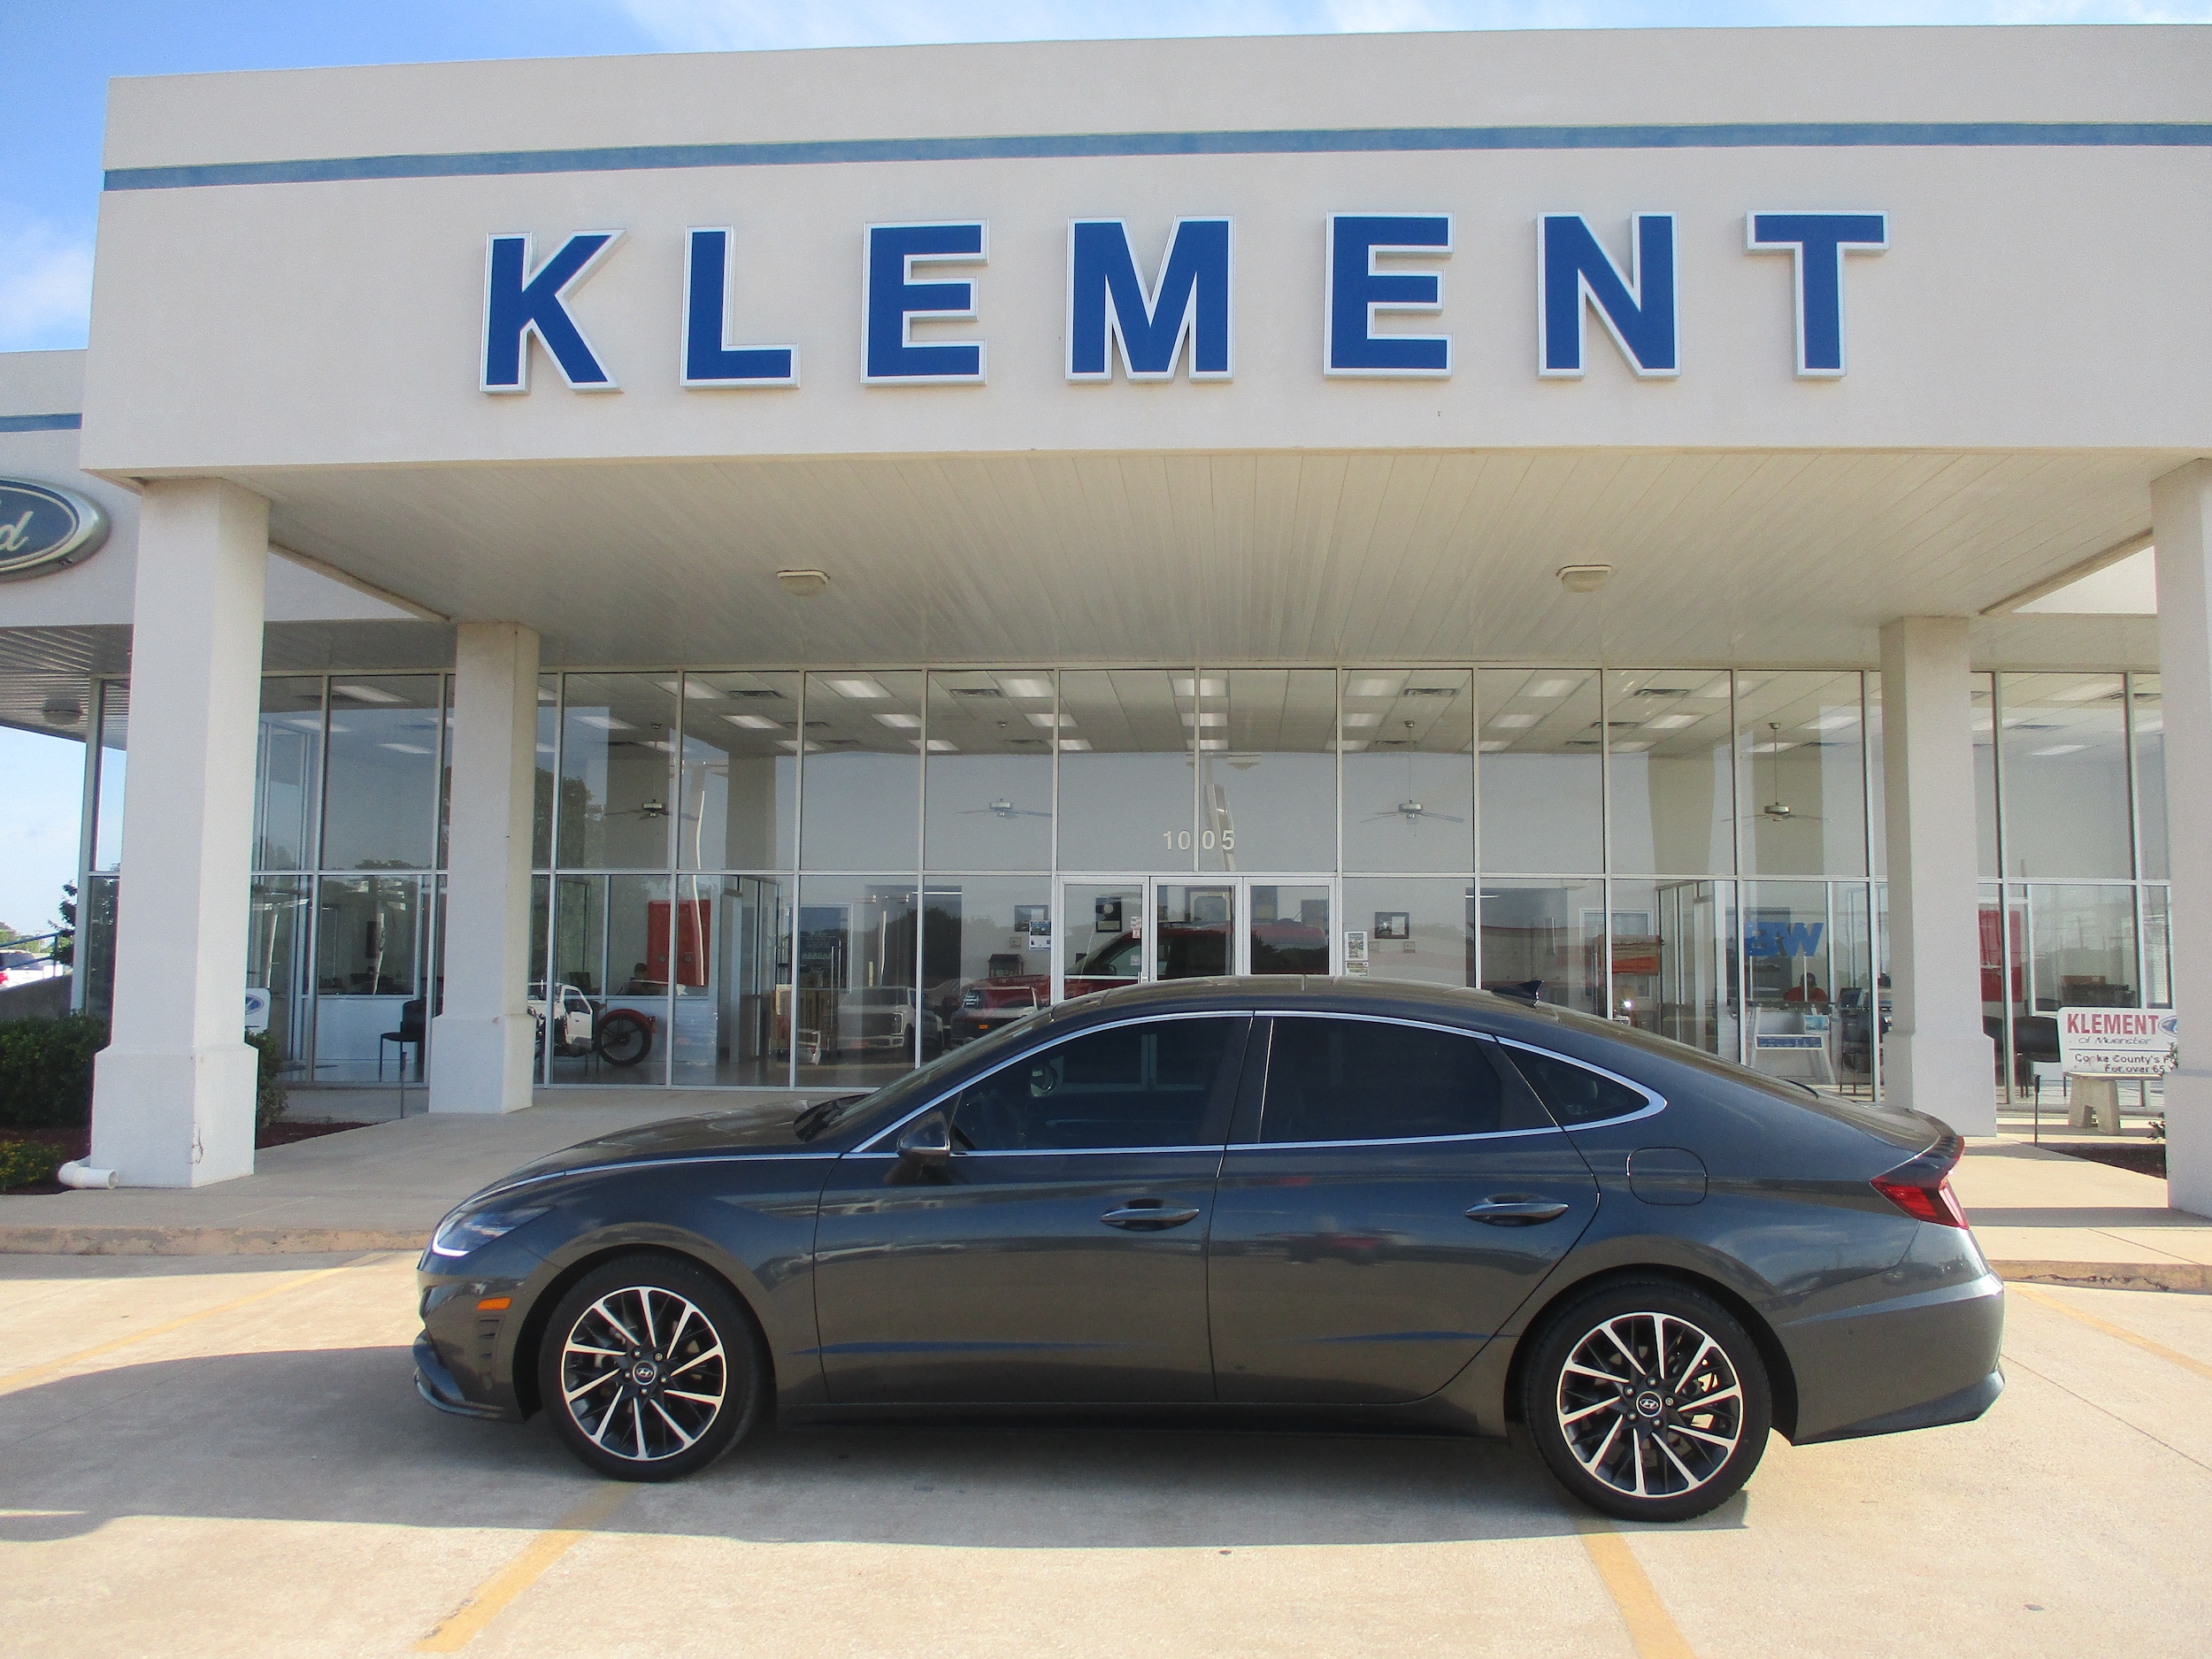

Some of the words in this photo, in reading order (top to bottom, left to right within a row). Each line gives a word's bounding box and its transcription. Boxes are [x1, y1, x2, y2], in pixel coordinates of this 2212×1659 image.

[480, 210, 1890, 395] KLEMENT
[1163, 829, 1235, 850] 1005
[2067, 1013, 2159, 1034] KLEMENT
[2094, 1036, 2152, 1045] Muenster
[2075, 1053, 2108, 1063] Coke
[2112, 1054, 2160, 1064] County's
[2153, 1064, 2165, 1074] 65
